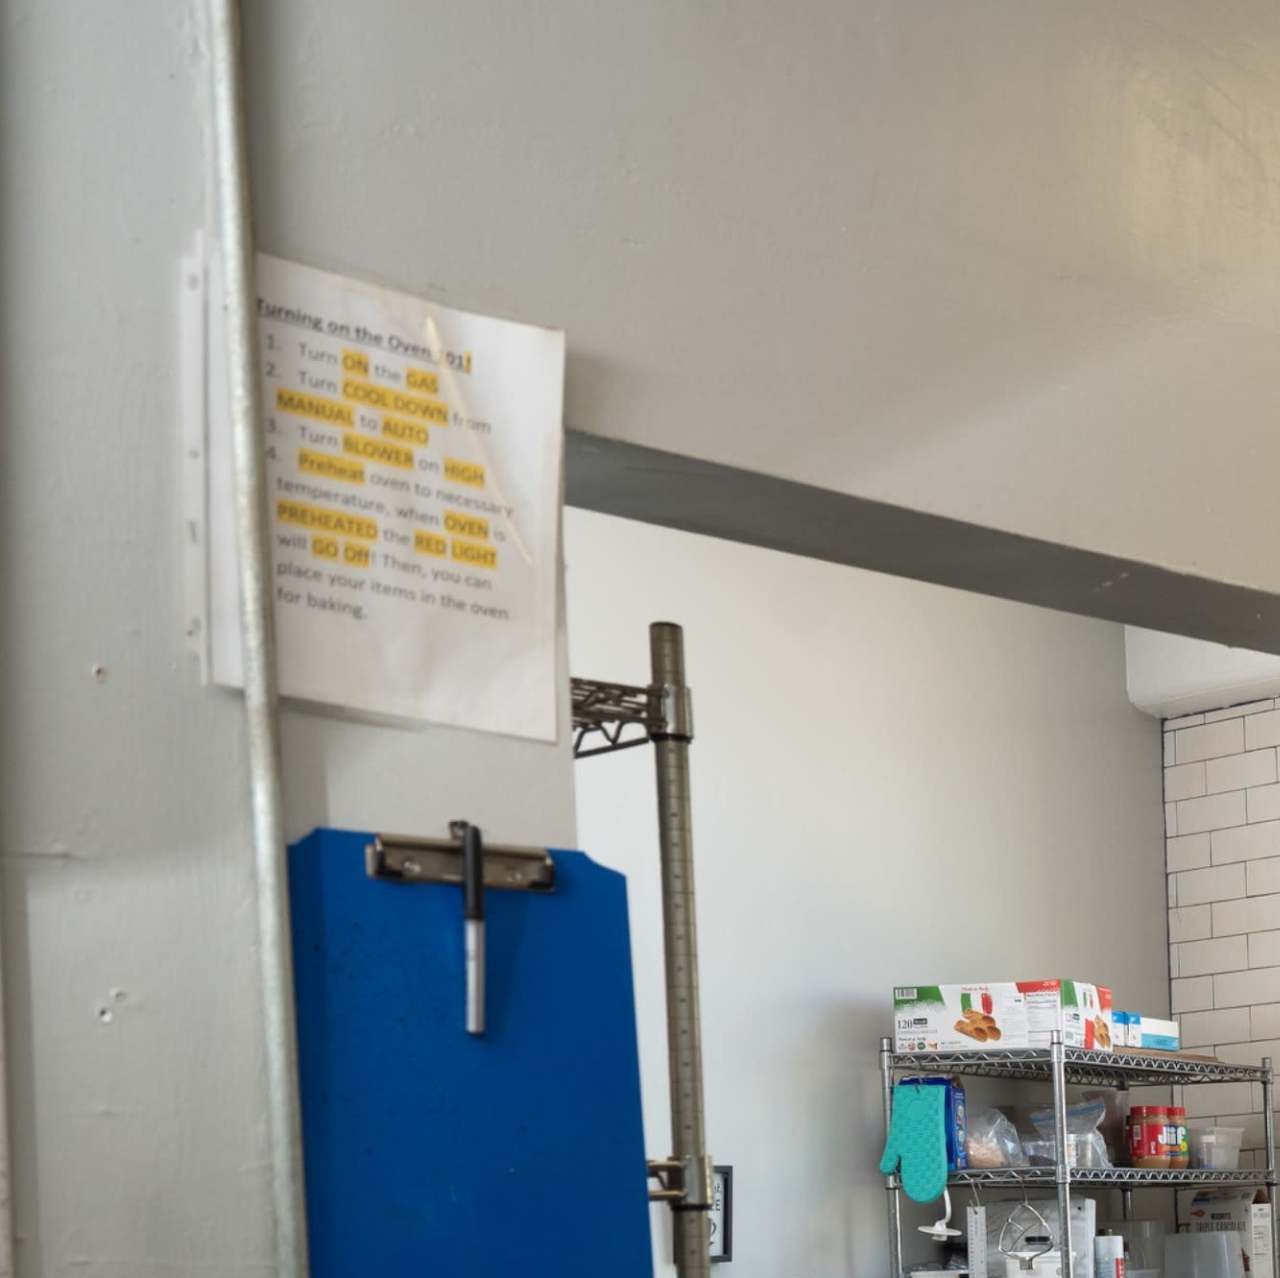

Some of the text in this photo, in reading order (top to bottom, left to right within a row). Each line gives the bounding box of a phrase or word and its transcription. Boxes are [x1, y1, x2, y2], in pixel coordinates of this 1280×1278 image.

[256, 300, 323, 332] Turning
[327, 322, 350, 336] on
[355, 326, 383, 346] the
[388, 335, 432, 357] Oven
[299, 342, 337, 364] Turn
[343, 354, 368, 372] ON
[374, 363, 402, 381] the
[407, 372, 438, 393] GAS
[276, 391, 429, 444] MANUAL to AUTO
[299, 371, 337, 393] Turn
[343, 381, 390, 406] COOL
[394, 396, 448, 422] DOWN
[299, 426, 338, 448] Turn
[343, 435, 414, 466] BLOWER
[418, 458, 440, 472] on
[443, 461, 485, 485] HIGH
[277, 477, 506, 542] temperature, when OVEN is
[299, 451, 365, 482] Preheat
[369, 473, 410, 491] oven
[415, 482, 430, 498] to
[436, 489, 513, 519] necessary
[277, 503, 497, 566] PREHEATED the RED LIGHT
[277, 534, 306, 550] will
[312, 537, 338, 558] GO
[382, 553, 427, 579] Then,
[431, 567, 460, 587] you
[464, 574, 492, 590] can
[277, 560, 510, 620] place your items in the oven
[277, 587, 368, 621] for baking.
